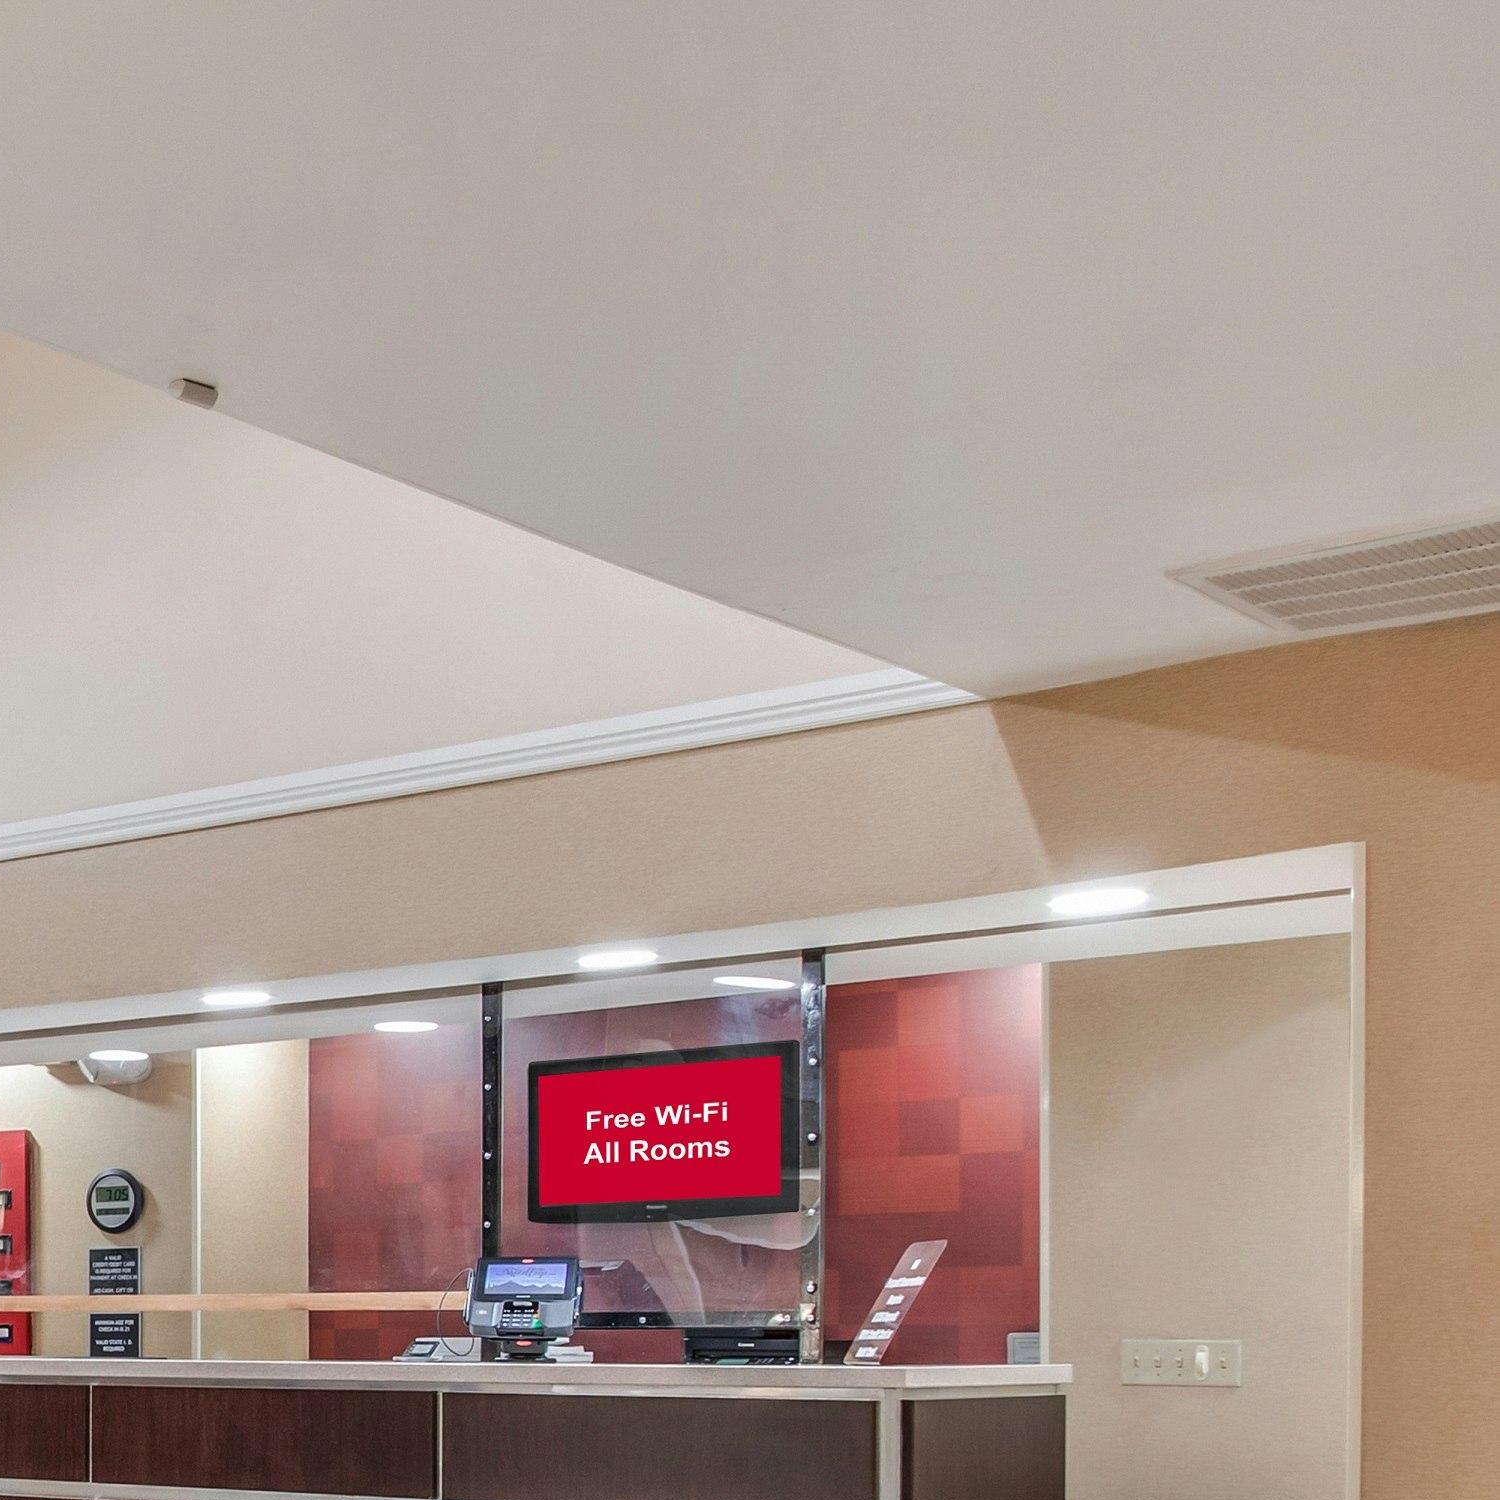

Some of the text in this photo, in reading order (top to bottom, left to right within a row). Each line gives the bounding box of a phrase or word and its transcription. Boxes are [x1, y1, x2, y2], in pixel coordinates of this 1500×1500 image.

[586, 1101, 728, 1130] Free Wi-Fi
[583, 1140, 731, 1164] All Rooms
